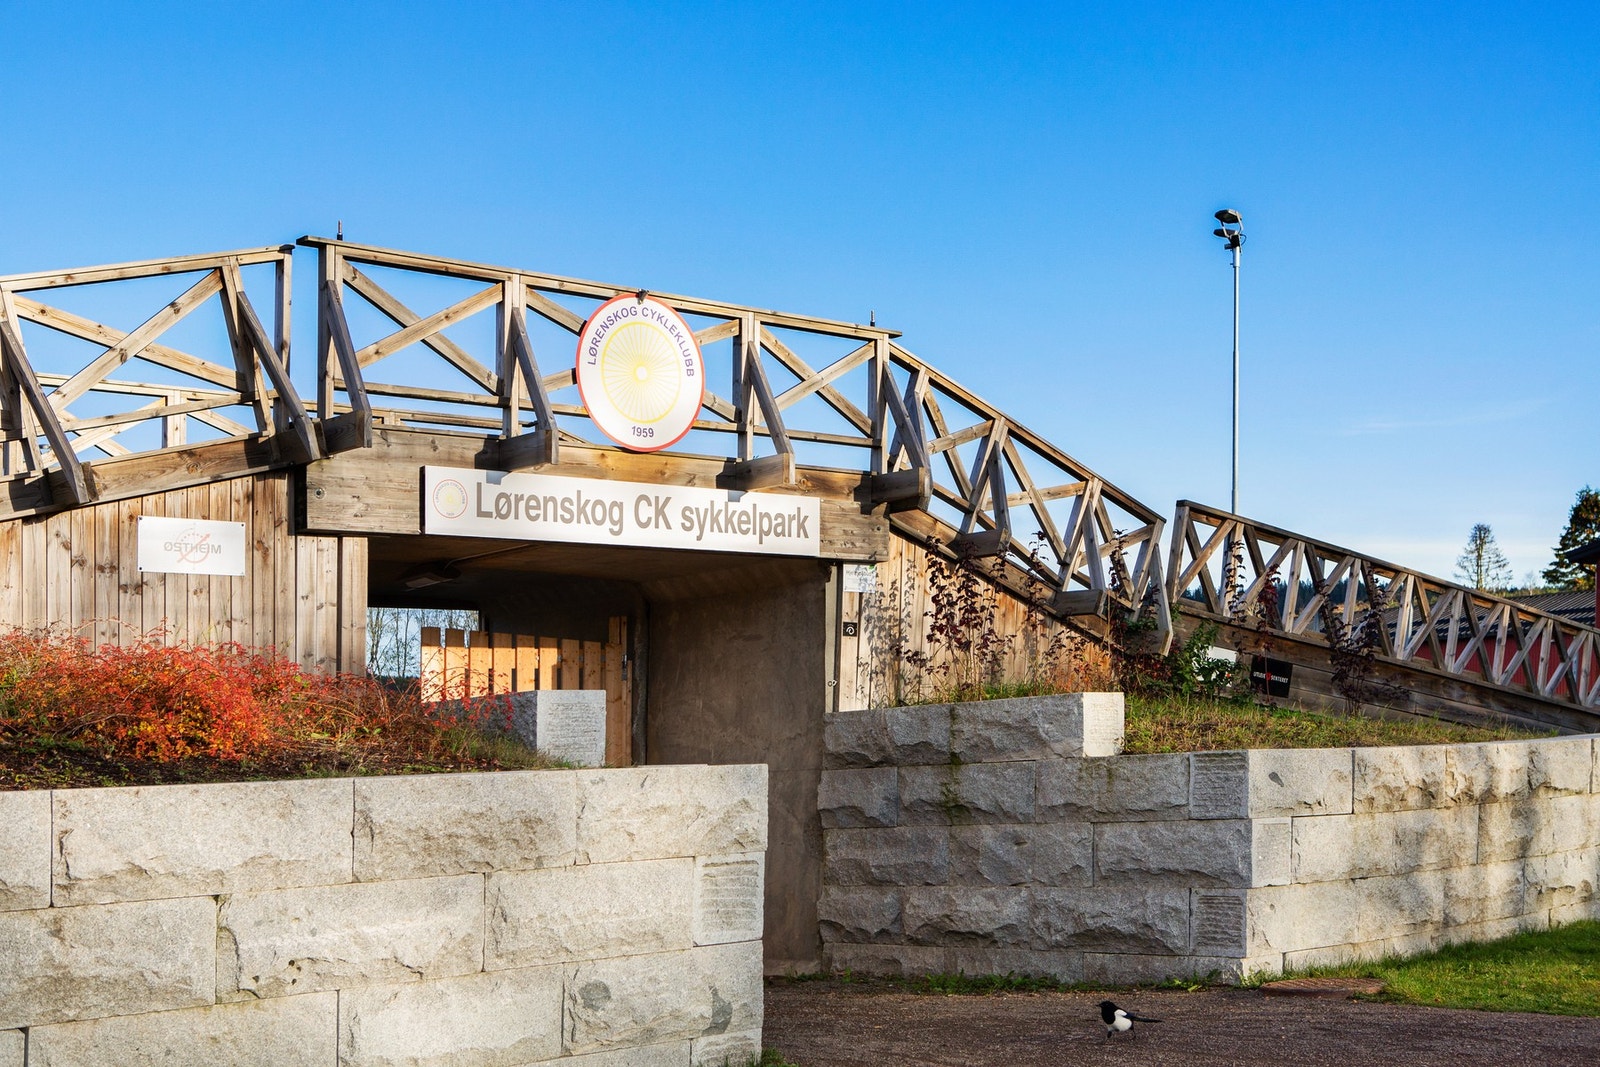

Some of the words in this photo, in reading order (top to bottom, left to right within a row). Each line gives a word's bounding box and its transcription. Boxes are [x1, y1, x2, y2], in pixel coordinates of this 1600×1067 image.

[588, 306, 638, 366] LØRENSKOG
[641, 307, 695, 377] CYKLEKLUBB
[631, 425, 654, 438] 1959
[475, 481, 624, 537] Lørenskog
[633, 493, 673, 531] CK
[680, 500, 810, 545] sykkelpark
[163, 541, 222, 555] ØSTHEIM
